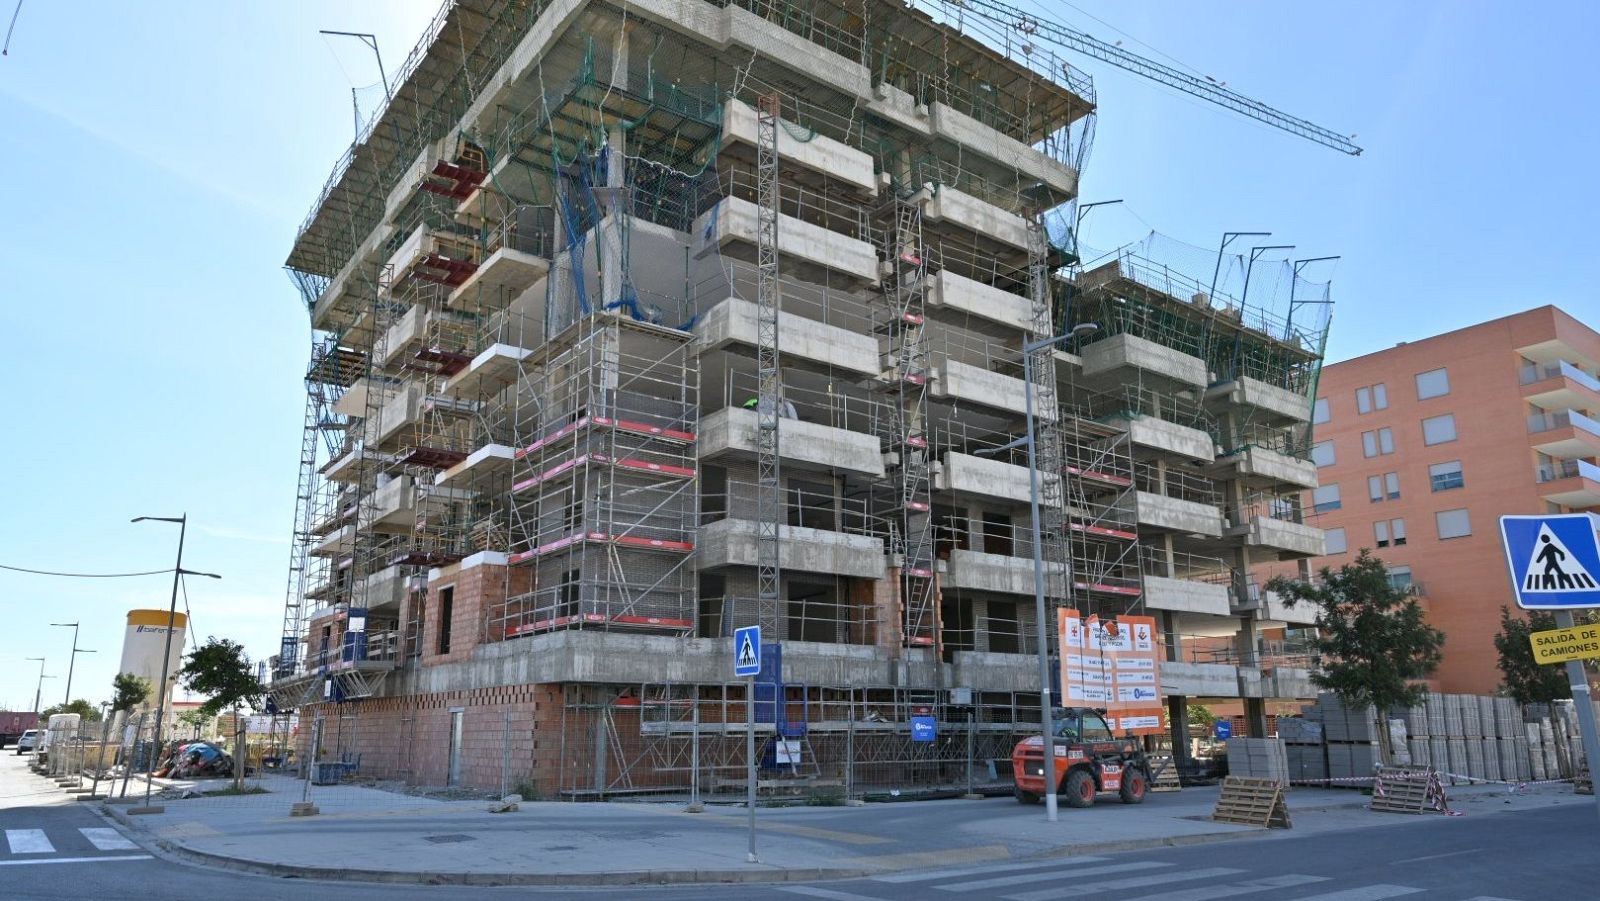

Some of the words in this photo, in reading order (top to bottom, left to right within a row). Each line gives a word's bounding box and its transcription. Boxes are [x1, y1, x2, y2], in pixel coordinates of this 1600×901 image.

[1536, 633, 1576, 646] SALIDA
[1581, 630, 1598, 640] DE
[1541, 642, 1599, 657] CAMIONES
